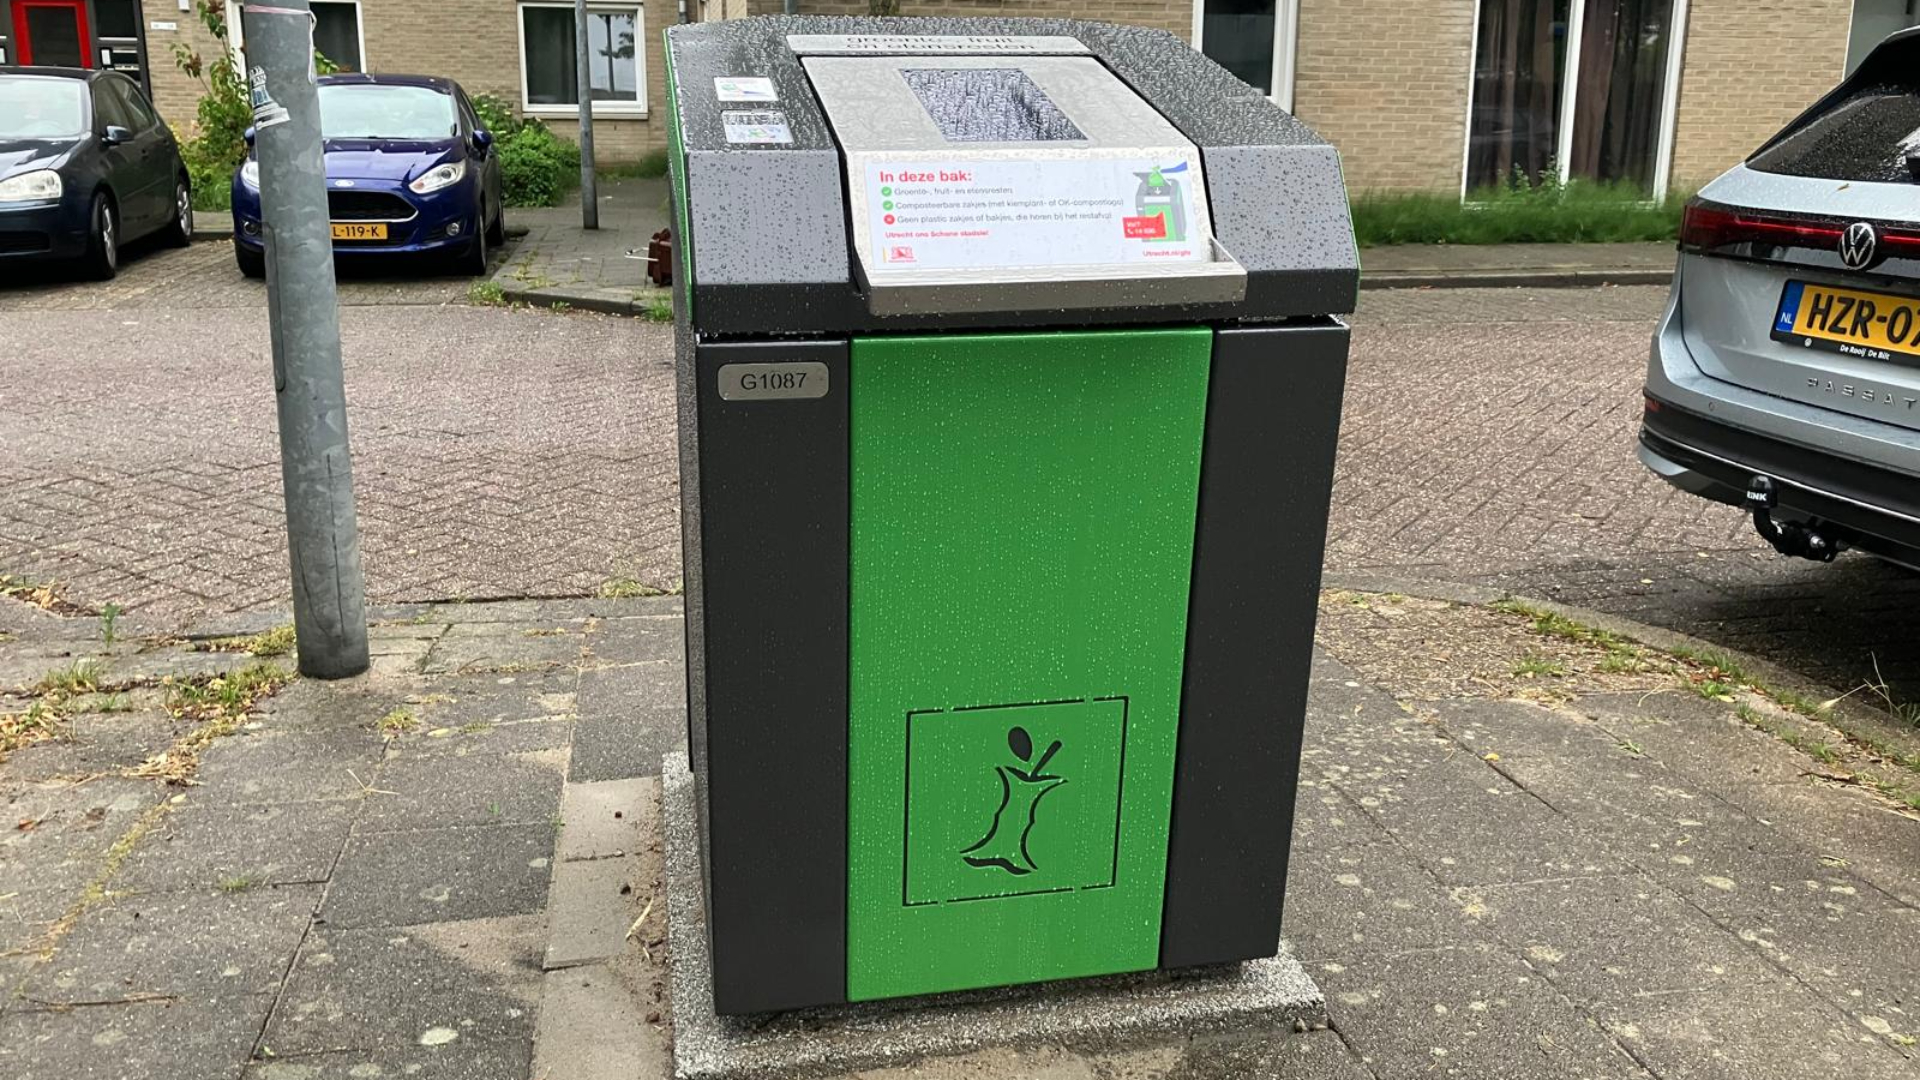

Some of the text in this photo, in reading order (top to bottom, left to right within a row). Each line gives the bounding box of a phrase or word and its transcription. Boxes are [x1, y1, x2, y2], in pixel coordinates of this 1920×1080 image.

[879, 170, 972, 182] In deze bak:
[895, 201, 960, 210] Composteerbare
[962, 201, 986, 210] zakjes
[988, 201, 1005, 209] (met
[897, 215, 918, 223] Geen
[921, 215, 946, 224] plastic
[950, 215, 973, 224] zakjes
[986, 214, 1014, 223] bakjes,
[1030, 213, 1051, 221] horen
[1054, 213, 1064, 222] bij
[332, 225, 380, 238] L-119-K
[885, 231, 913, 239] Utrecht
[1780, 311, 1793, 325] NL
[1839, 344, 1849, 353] De
[741, 372, 808, 391] G1087
[1806, 376, 1917, 410] PASSAT
